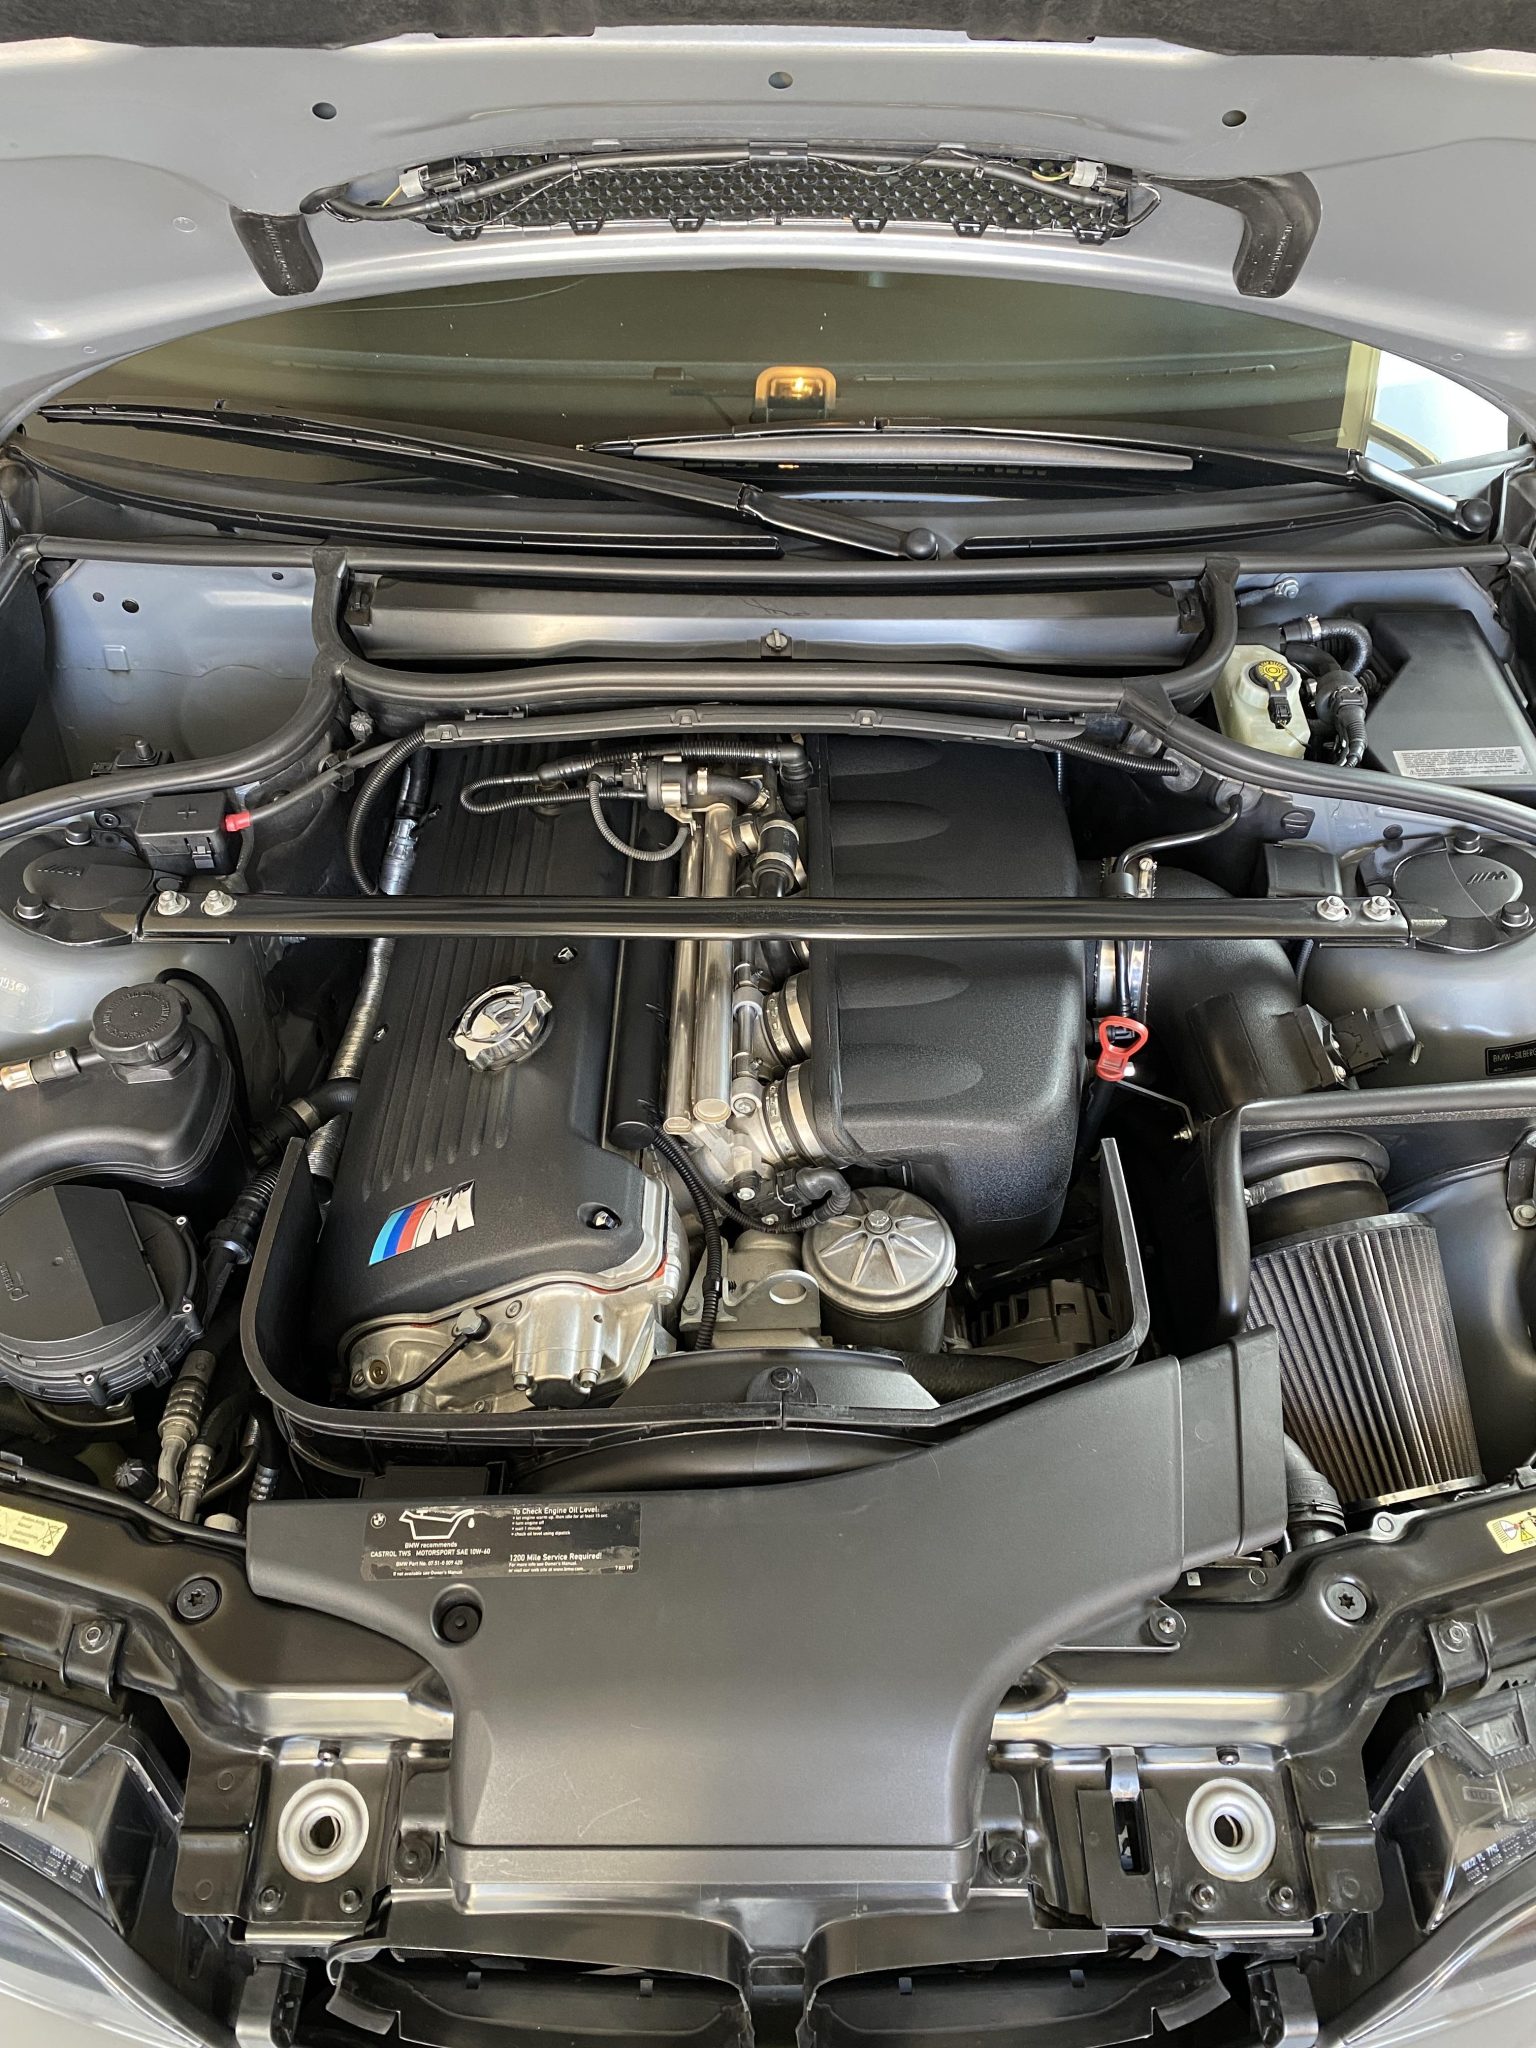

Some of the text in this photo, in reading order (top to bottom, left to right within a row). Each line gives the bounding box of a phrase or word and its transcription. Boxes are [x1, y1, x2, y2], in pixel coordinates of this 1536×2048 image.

[522, 1507, 542, 1515] Check
[544, 1506, 567, 1516] Engine
[370, 1550, 397, 1558] CASTROL
[456, 1548, 468, 1556] SAE
[509, 1552, 602, 1562] 1200 Mile Service Required!
